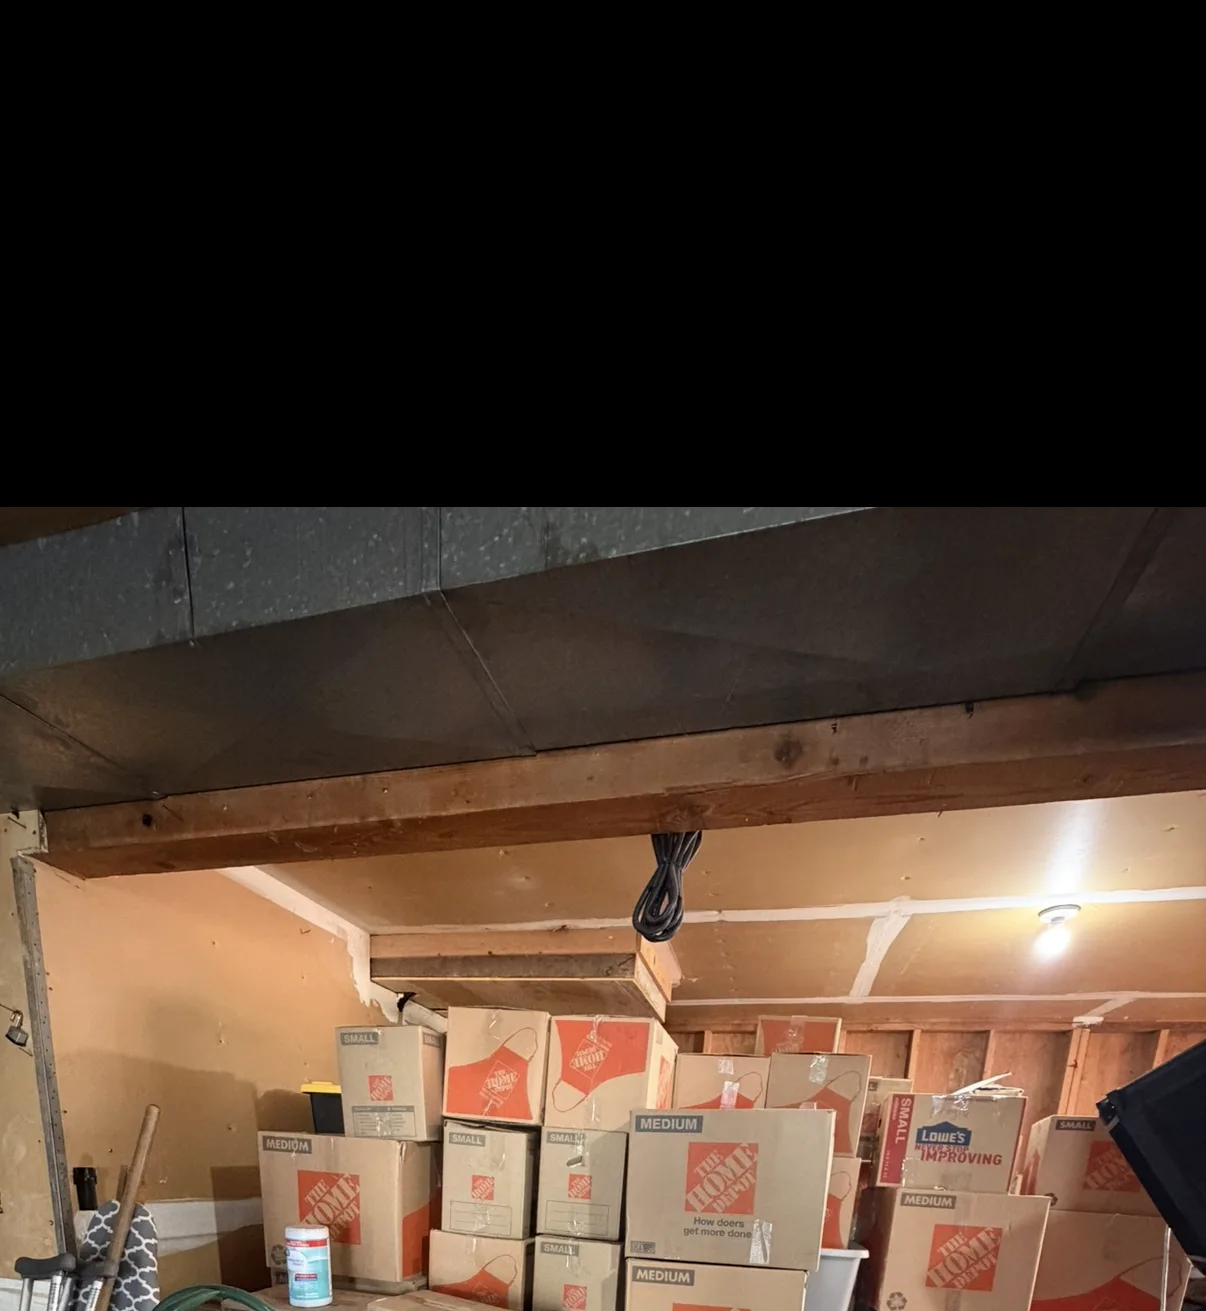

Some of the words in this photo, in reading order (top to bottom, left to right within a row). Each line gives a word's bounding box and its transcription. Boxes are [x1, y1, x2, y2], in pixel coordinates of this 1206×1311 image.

[344, 1034, 375, 1044] SMALL
[640, 1118, 697, 1130] MEDIUM
[895, 1098, 912, 1144] SMALL
[1059, 1121, 1092, 1130] SMALL
[266, 1138, 310, 1152] MEDIUM
[452, 1134, 482, 1145] SMALL
[550, 1133, 584, 1145] SMALL
[921, 1130, 967, 1144] LOWE'S
[693, 1150, 723, 1179] THE
[920, 1150, 1003, 1166] IMPROVING
[686, 1143, 758, 1213] HOME
[304, 1178, 330, 1207] THE
[472, 1177, 495, 1200] HOME
[568, 1176, 593, 1199] HOME
[711, 1168, 757, 1214] DEPOT
[904, 1195, 953, 1207] MEDIUM
[693, 1217, 715, 1226] How
[717, 1218, 744, 1228] doers
[683, 1227, 699, 1237] get
[700, 1229, 725, 1237] more
[544, 1243, 576, 1255] SMALL
[937, 1232, 968, 1257] THE
[926, 1227, 1001, 1289] HOME
[636, 1268, 690, 1284] MEDIUM
[952, 1252, 999, 1290] DEPOT
